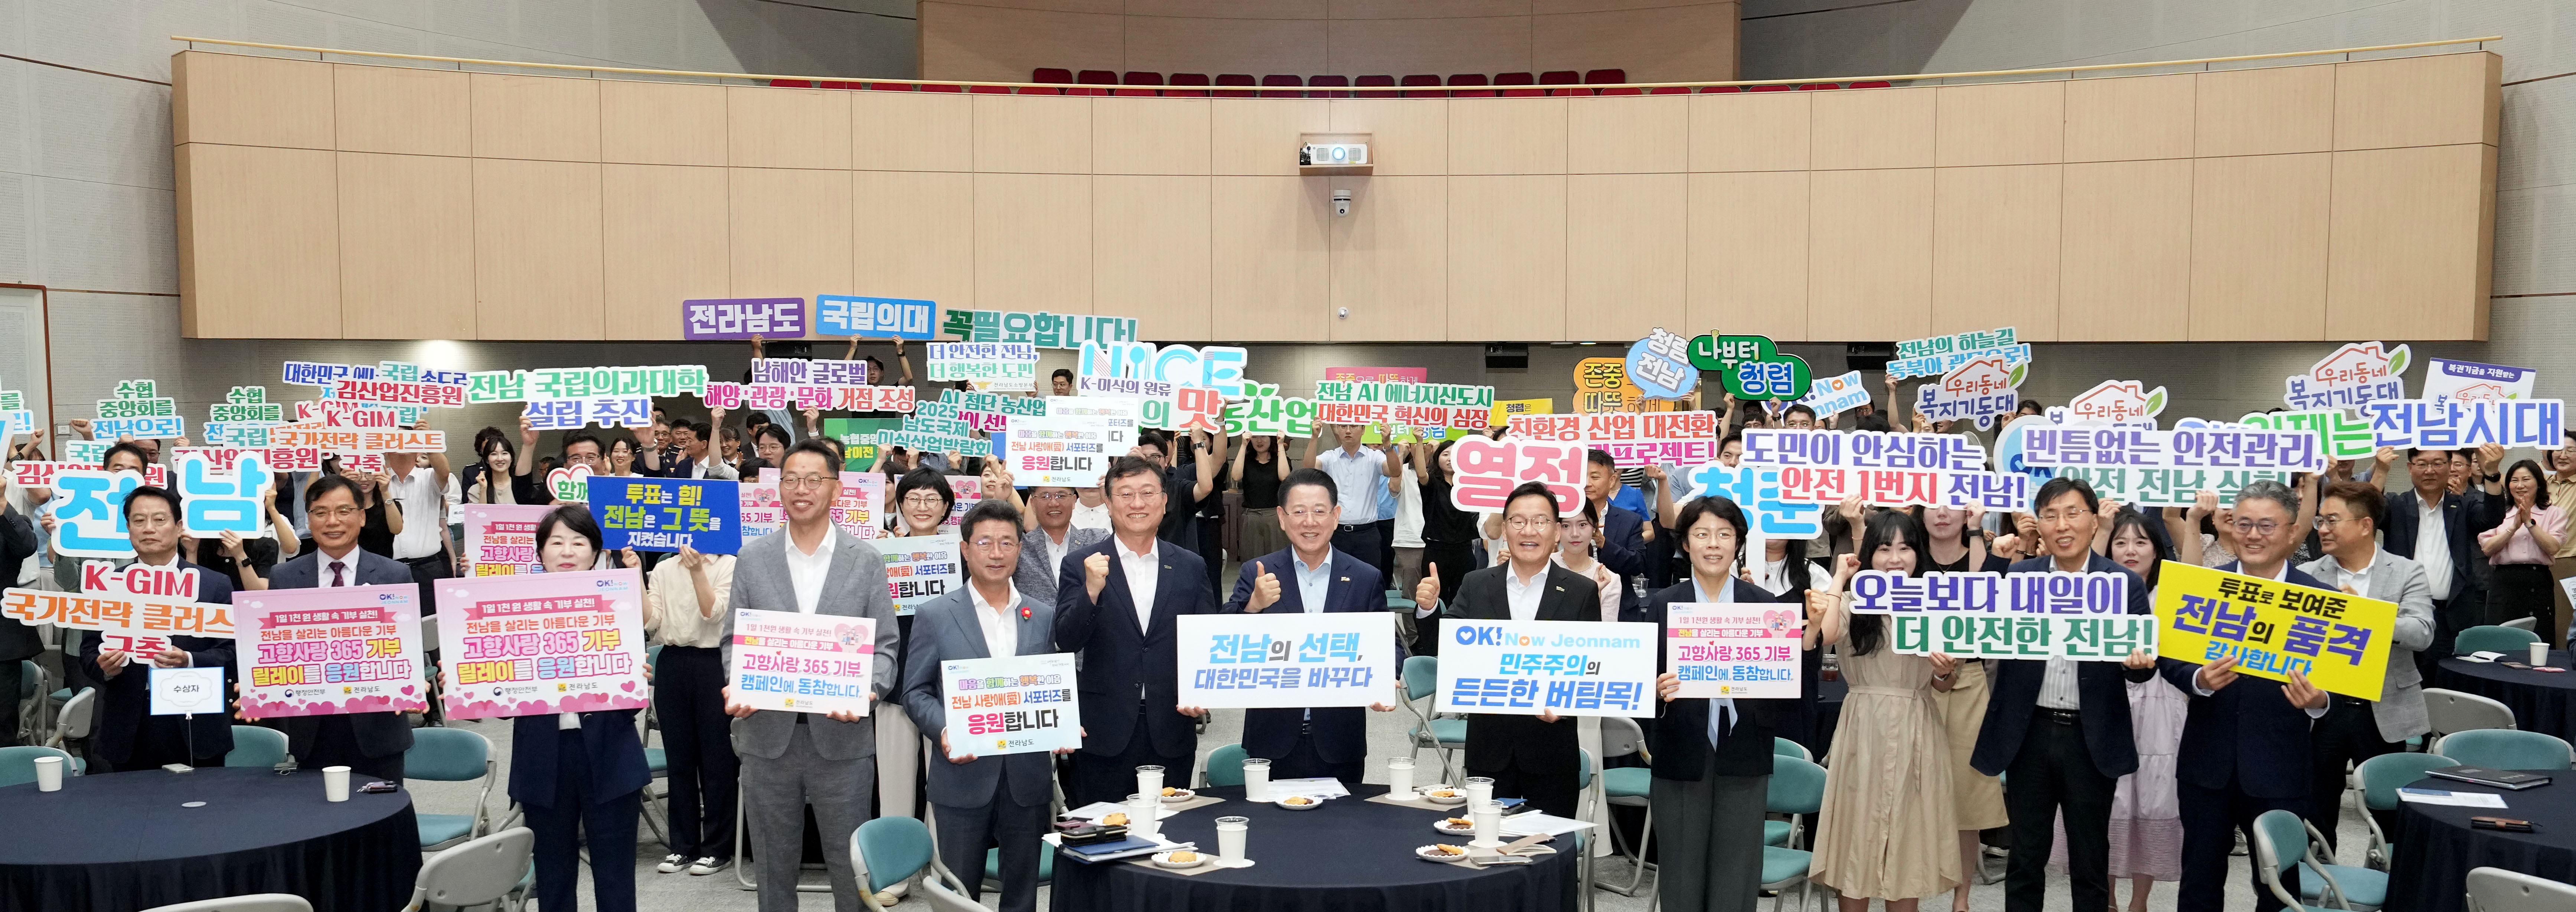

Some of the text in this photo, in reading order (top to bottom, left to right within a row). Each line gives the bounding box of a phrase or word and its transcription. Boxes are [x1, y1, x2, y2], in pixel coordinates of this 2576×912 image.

[689, 303, 801, 334] 전라남도
[823, 300, 929, 333] 국립의대
[943, 308, 974, 341] 꼭
[973, 311, 1136, 347] 필요합니다!
[929, 344, 1037, 361] 더 안전한 전남,
[1647, 327, 1689, 366] 청렴
[1698, 340, 1759, 369] 나부터
[1898, 327, 2014, 359] 전남의 하늘길
[382, 364, 418, 381] 국립
[752, 361, 867, 385] 남해안 글로벌
[930, 363, 1033, 378] 더 행복한 도민
[1636, 352, 1685, 390] 전남
[1740, 363, 1792, 395] 청렴
[1888, 357, 1942, 378] 동북아
[2324, 362, 2386, 387] 우리동네
[2449, 364, 2514, 378] 복권기금을 지원받는
[117, 382, 153, 399] 수협
[229, 389, 262, 404] 수협
[337, 380, 462, 405] 김산업진흥원
[468, 374, 526, 401] 전남
[535, 369, 705, 397] 국립의과대학
[1081, 377, 1172, 396] K-미식의 원류
[1317, 384, 1492, 408] 전남 AI 에너지신도시
[1955, 375, 2007, 397] 우리동네
[100, 399, 173, 418] 중앙회를
[839, 387, 914, 411] 거점 조성
[917, 402, 957, 419] 2025
[940, 391, 997, 412] AI 첨단
[1178, 388, 1221, 431] 맛
[1506, 403, 1532, 412] 청렴은
[1920, 390, 2014, 427] 복지기동대
[2082, 400, 2144, 421] 우리동네
[2289, 380, 2399, 417] 복지기동대
[213, 406, 280, 421] 중앙회를
[327, 410, 395, 427] K-GIM
[525, 398, 649, 427] 설립 추진
[1319, 403, 1489, 429] 대한민국 혁신의 심장
[93, 419, 181, 439] 전남으로!
[226, 428, 267, 446] 국립
[904, 416, 969, 437] 남도국제
[1509, 413, 1714, 441] 친환경 산업 대전환
[2374, 403, 2559, 447] 전남시대
[280, 432, 359, 449] 국가전략
[878, 431, 991, 456] 미식산업박람회
[1011, 442, 1103, 452] 전남 서포터즈를
[1745, 433, 1840, 465] 도민이
[1852, 434, 1982, 471] 안심하는
[2025, 429, 2322, 470] 빈틈없는 안전관리,
[1022, 456, 1092, 471] 응원합니다
[1457, 441, 1582, 512] 열정
[1782, 467, 2024, 508] 안전 1번지 전남!
[2137, 469, 2206, 503] 전남
[626, 484, 702, 506] 투표는 힘!
[604, 506, 721, 532] 전남은 그 뜻을
[628, 532, 693, 548] 지켰습니다
[481, 546, 534, 561] 고향사랑
[85, 565, 193, 597] K-GIM
[915, 563, 956, 576] 서포터즈를
[1855, 575, 2122, 614] 오늘보다 내일이
[2218, 578, 2347, 620] 투표로 보여준
[6, 593, 235, 633] 국가전략 클러스
[466, 615, 615, 633] 전남을 살리는 아름다운 기부
[261, 625, 396, 641] 전남을 살리는 아름다운 기부
[1456, 626, 1640, 648] OK! Now Jeonnam
[1897, 616, 2152, 656] 더 안전한 전남!
[2173, 594, 2372, 666] 전남의 품격
[258, 638, 401, 663] 고향사랑 365 기부
[464, 629, 621, 659] 고향사랑 365 기부
[1209, 632, 1363, 664] 전남의 선택,
[1678, 645, 1790, 661] 고향사랑 365 기부
[457, 653, 632, 685] 릴레이를 응원합니다
[743, 654, 861, 677] 고향사랑 365 기부
[1499, 654, 1601, 676] 민주주의의
[2205, 641, 2312, 676] 감사합니다
[252, 659, 411, 687] 릴레이를 응원합니다
[959, 674, 1061, 690] 마음을 이음
[1194, 667, 1373, 689] 대한민국을 바꾸다
[1678, 666, 1791, 681] 캠페인에 동참합니다
[174, 684, 199, 693] 수상자
[741, 674, 860, 698] 캠페인에 동참합니다
[1452, 678, 1643, 710] 든든한 버팀목!
[951, 689, 1071, 709] 전남 서포터즈를
[967, 709, 1059, 735] 응원합니다
[1008, 739, 1035, 748] 전라남도
